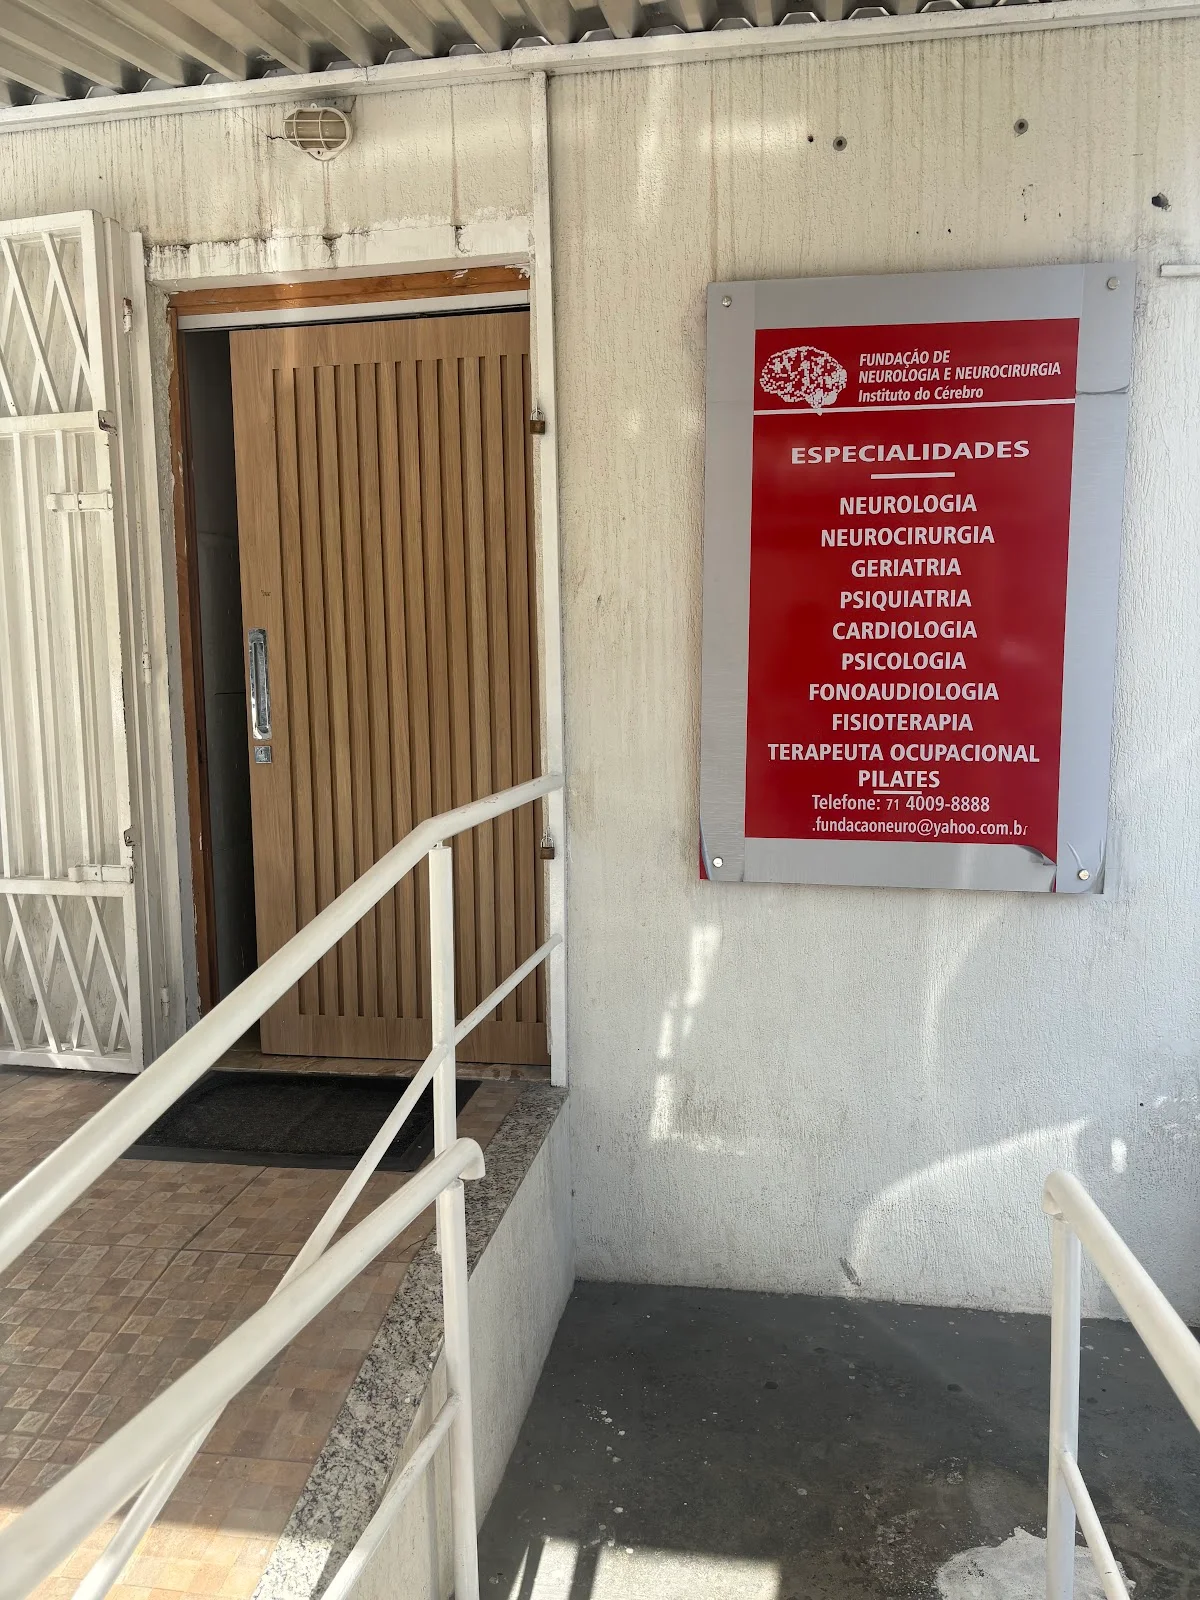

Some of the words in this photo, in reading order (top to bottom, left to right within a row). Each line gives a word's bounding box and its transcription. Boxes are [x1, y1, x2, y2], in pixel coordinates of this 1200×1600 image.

[932, 350, 951, 364] DE
[858, 367, 940, 384] NEUROLOGIA
[943, 367, 952, 381] E
[954, 361, 1062, 380] NEUROCIRURGIA
[857, 388, 911, 403] Instituto
[913, 386, 931, 401] do
[933, 384, 984, 400] Cérebro
[790, 440, 1030, 465] ESPECIALIDADES
[839, 493, 978, 516] NEUROLOGIA
[820, 525, 995, 547] NEUROCIRURGIA
[850, 557, 962, 578] GERIATRIA
[839, 589, 972, 612] PSIQUIATRIA
[832, 620, 978, 640] CARDIOLOGIA
[840, 651, 967, 671] PSICOLOGIA
[808, 682, 1000, 702] FONOAUDIOLOGIA
[831, 713, 974, 732] FISIOTERAPIA
[767, 743, 885, 762] TERAPEUTA
[889, 744, 1040, 763] OCUPACIONAL
[857, 769, 941, 789] PILATES
[811, 794, 881, 811] Telefone:
[885, 798, 900, 811] 71
[905, 795, 991, 812] 4009-8888
